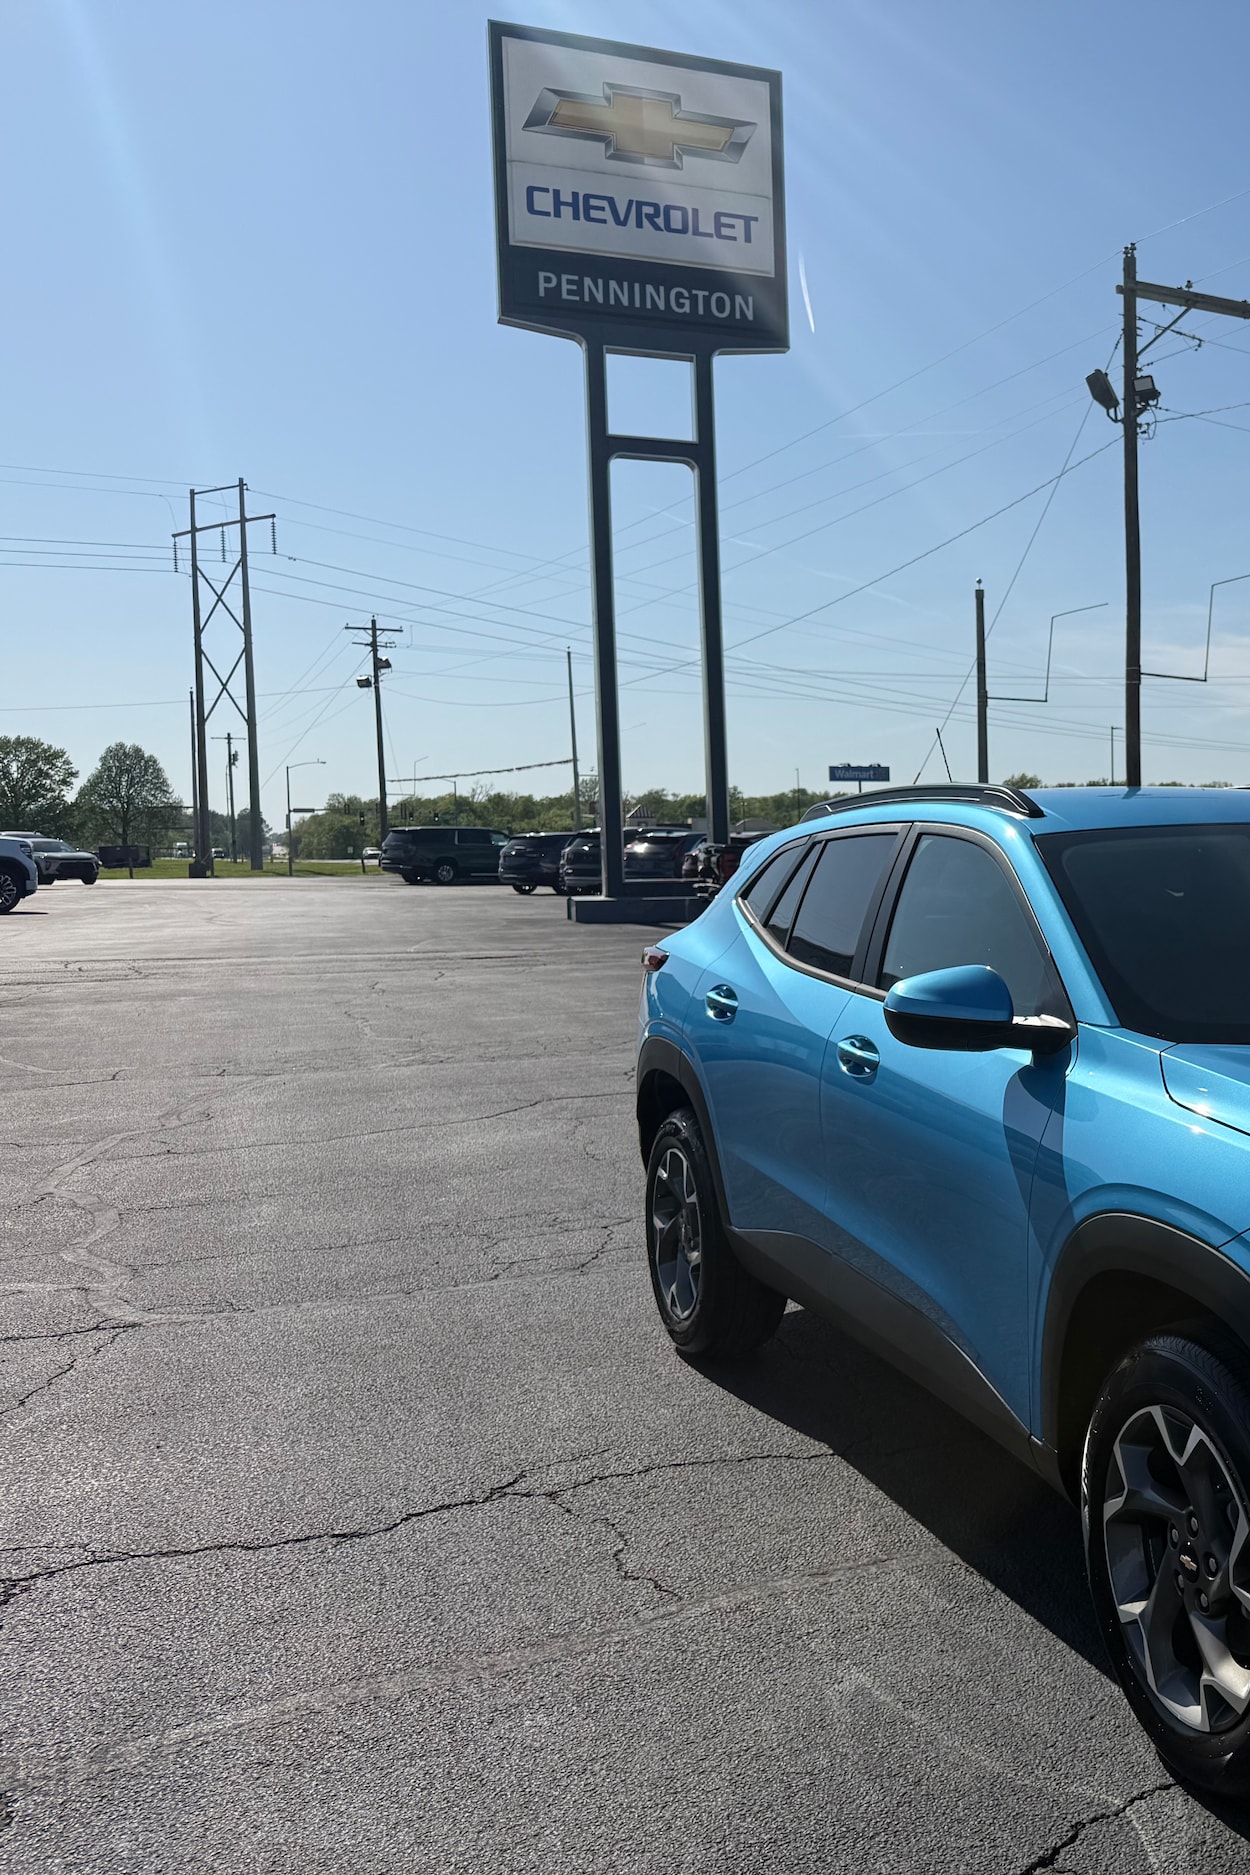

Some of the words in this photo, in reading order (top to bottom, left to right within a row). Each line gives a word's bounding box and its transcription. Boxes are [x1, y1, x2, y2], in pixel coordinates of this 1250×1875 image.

[526, 185, 759, 244] CHEVROLET
[538, 271, 755, 321] PENNINGTON
[834, 769, 875, 779] Walmart
